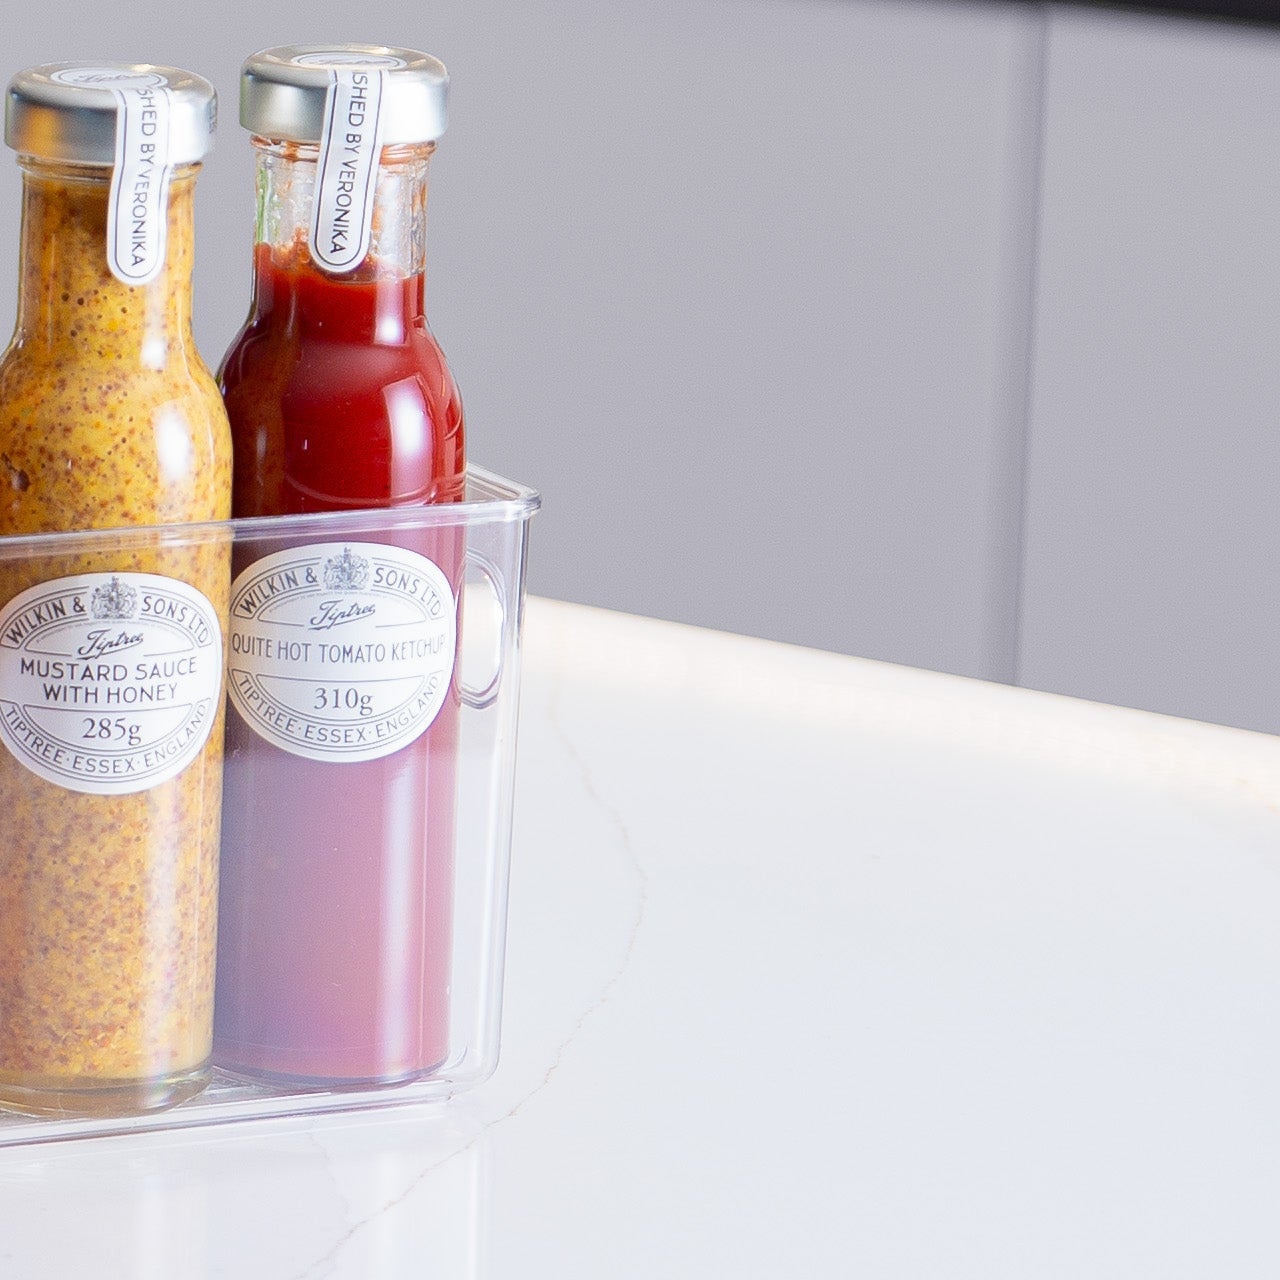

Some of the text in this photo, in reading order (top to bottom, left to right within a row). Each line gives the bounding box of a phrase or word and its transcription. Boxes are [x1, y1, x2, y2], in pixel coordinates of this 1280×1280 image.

[140, 143, 155, 165] BY
[344, 133, 362, 154] BY
[131, 170, 152, 267] VERONIKA
[330, 159, 358, 254] VERONIKA
[241, 570, 300, 614] WILKIN
[305, 567, 318, 583] &
[375, 567, 419, 594] SONS
[421, 585, 441, 616] LTD
[6, 598, 67, 644] WILKIN
[73, 596, 86, 613] &
[141, 595, 188, 625] SONS
[188, 614, 210, 644] LTD
[308, 599, 376, 631] Tiptree
[77, 628, 145, 661] Tiptree
[232, 632, 446, 663] QUITE HOT TOMATO KETCHUP
[20, 657, 198, 682] MUSTARD SAUCE
[43, 682, 178, 704] WITH HONEY
[239, 674, 439, 744] TIPTREE ESSEX ENGLAND
[314, 686, 374, 716] 310g
[4, 703, 207, 774] TIPTREE ESSEX ENGLAND
[82, 716, 142, 746] 285g
